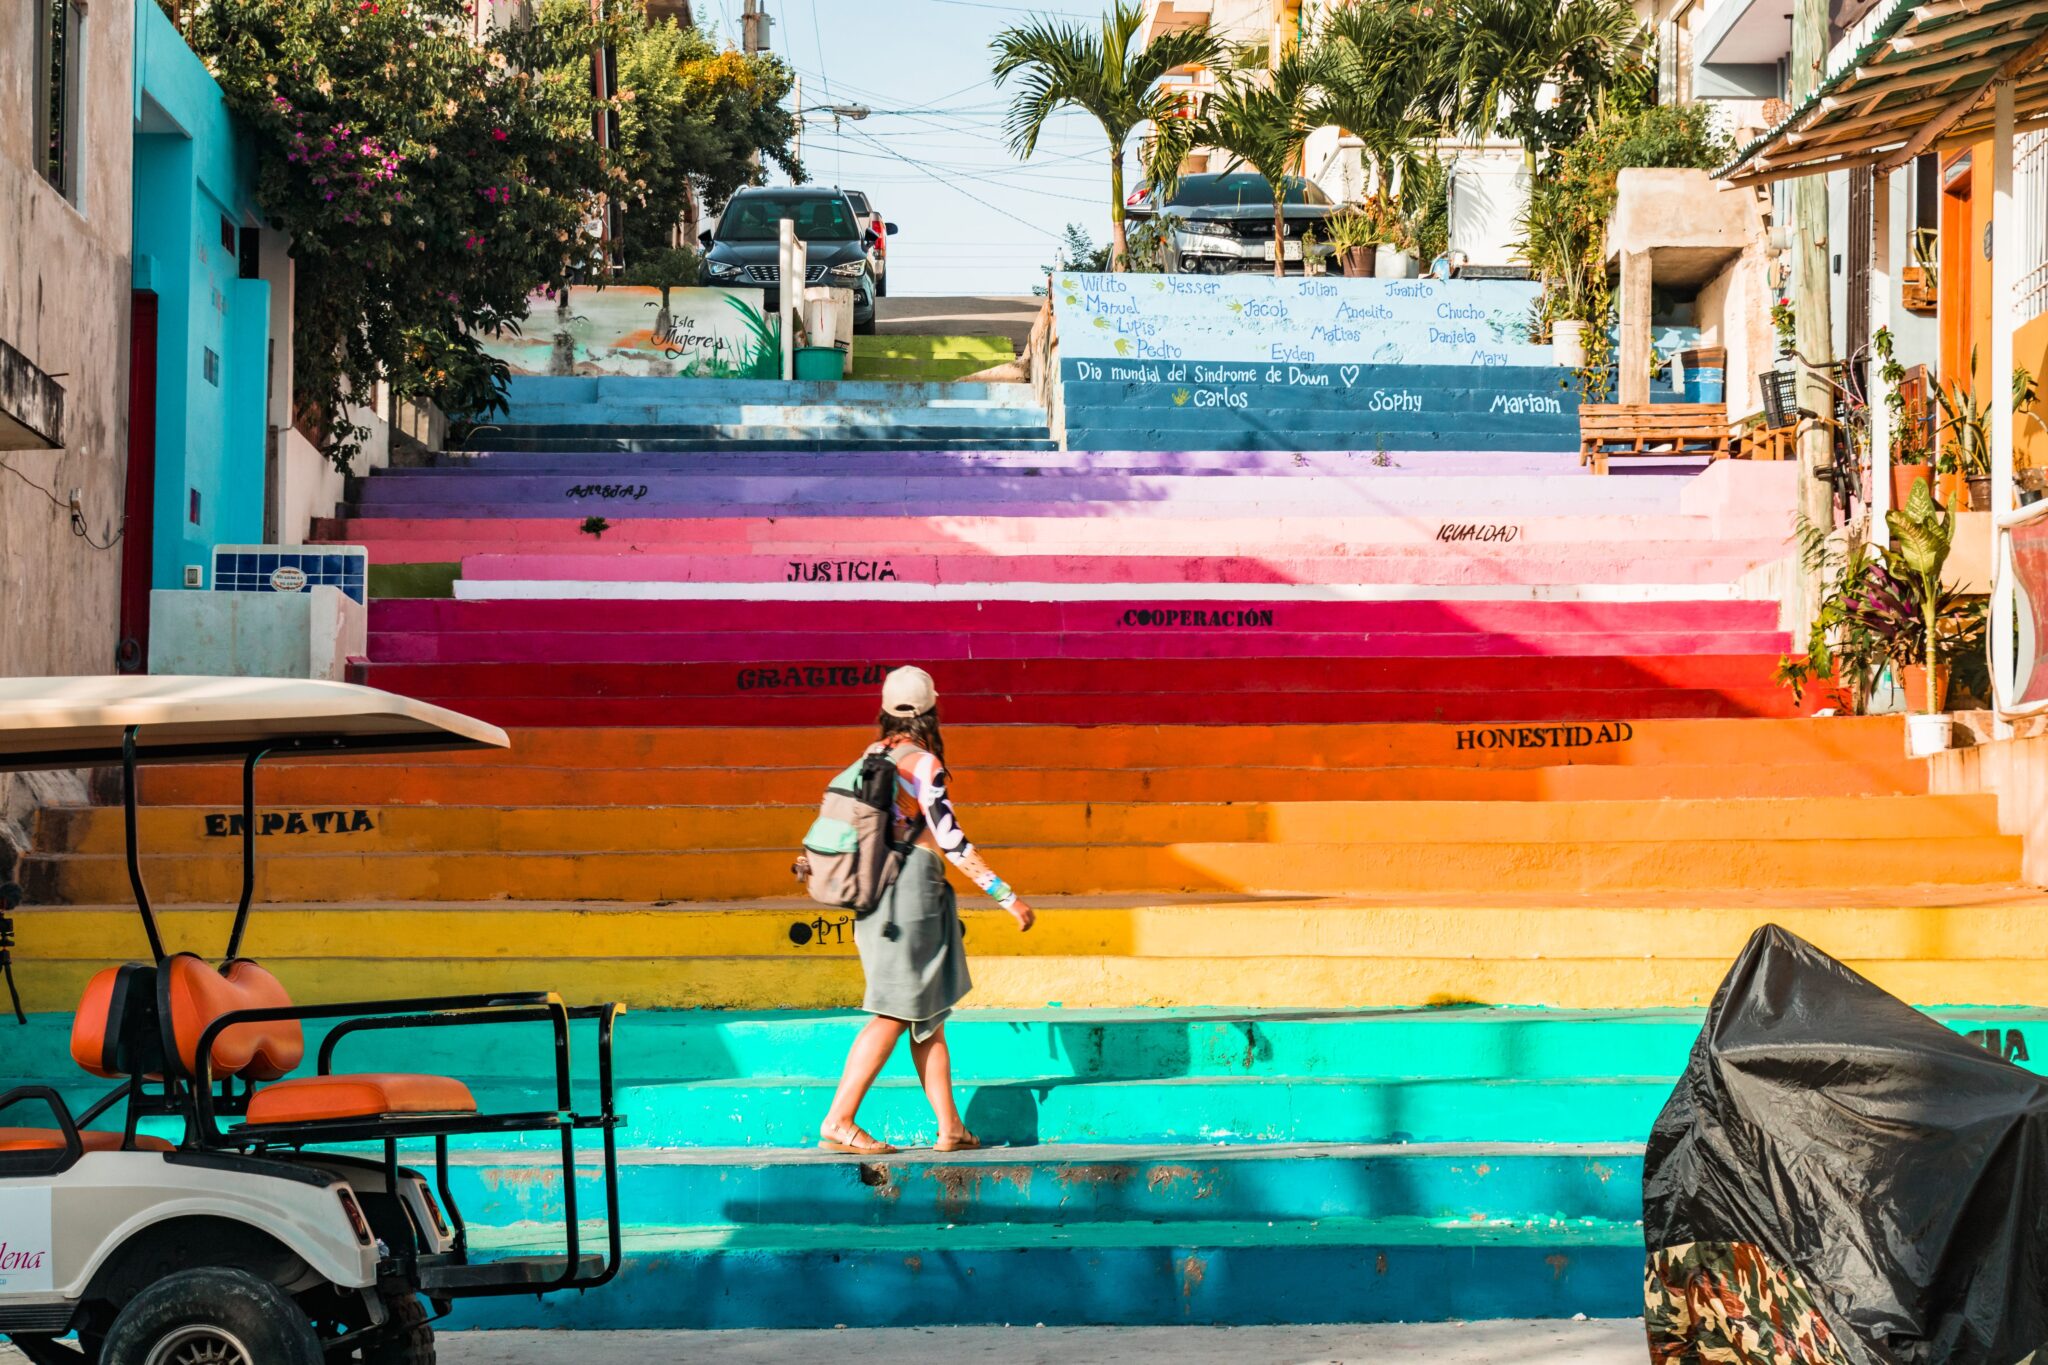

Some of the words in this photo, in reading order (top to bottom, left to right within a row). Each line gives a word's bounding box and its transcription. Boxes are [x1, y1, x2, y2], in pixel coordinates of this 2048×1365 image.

[1080, 274, 1127, 293] Wilito
[1298, 281, 1338, 297] Julian
[1384, 282, 1433, 298] Juanito
[1086, 294, 1140, 315] Manuel
[1243, 299, 1288, 317] Jacob
[1436, 302, 1486, 319] Chucho
[669, 315, 695, 329] Isla
[1310, 325, 1361, 342] Matias
[1429, 327, 1476, 344] Daniela
[651, 328, 729, 360] Mujeres
[1137, 338, 1182, 358] Pedro
[1271, 343, 1315, 363] Eyden
[1470, 350, 1508, 366] Mary
[1077, 361, 1102, 381] Dia
[1111, 364, 1161, 384] mundial
[1167, 363, 1187, 382] del
[1194, 365, 1257, 384] Sindrome
[1265, 365, 1282, 383] de
[1288, 366, 1329, 386] Down
[1193, 386, 1248, 409] Carlos
[1368, 389, 1422, 412] Sophy
[1489, 393, 1561, 414] Mariam
[1436, 523, 1518, 542] IGUALDAD
[787, 560, 897, 582] JUSTICIA
[1123, 607, 1274, 627] COOPERACIÓN
[736, 664, 897, 690] GRATITU
[1456, 722, 1633, 750] HONESTIDAD
